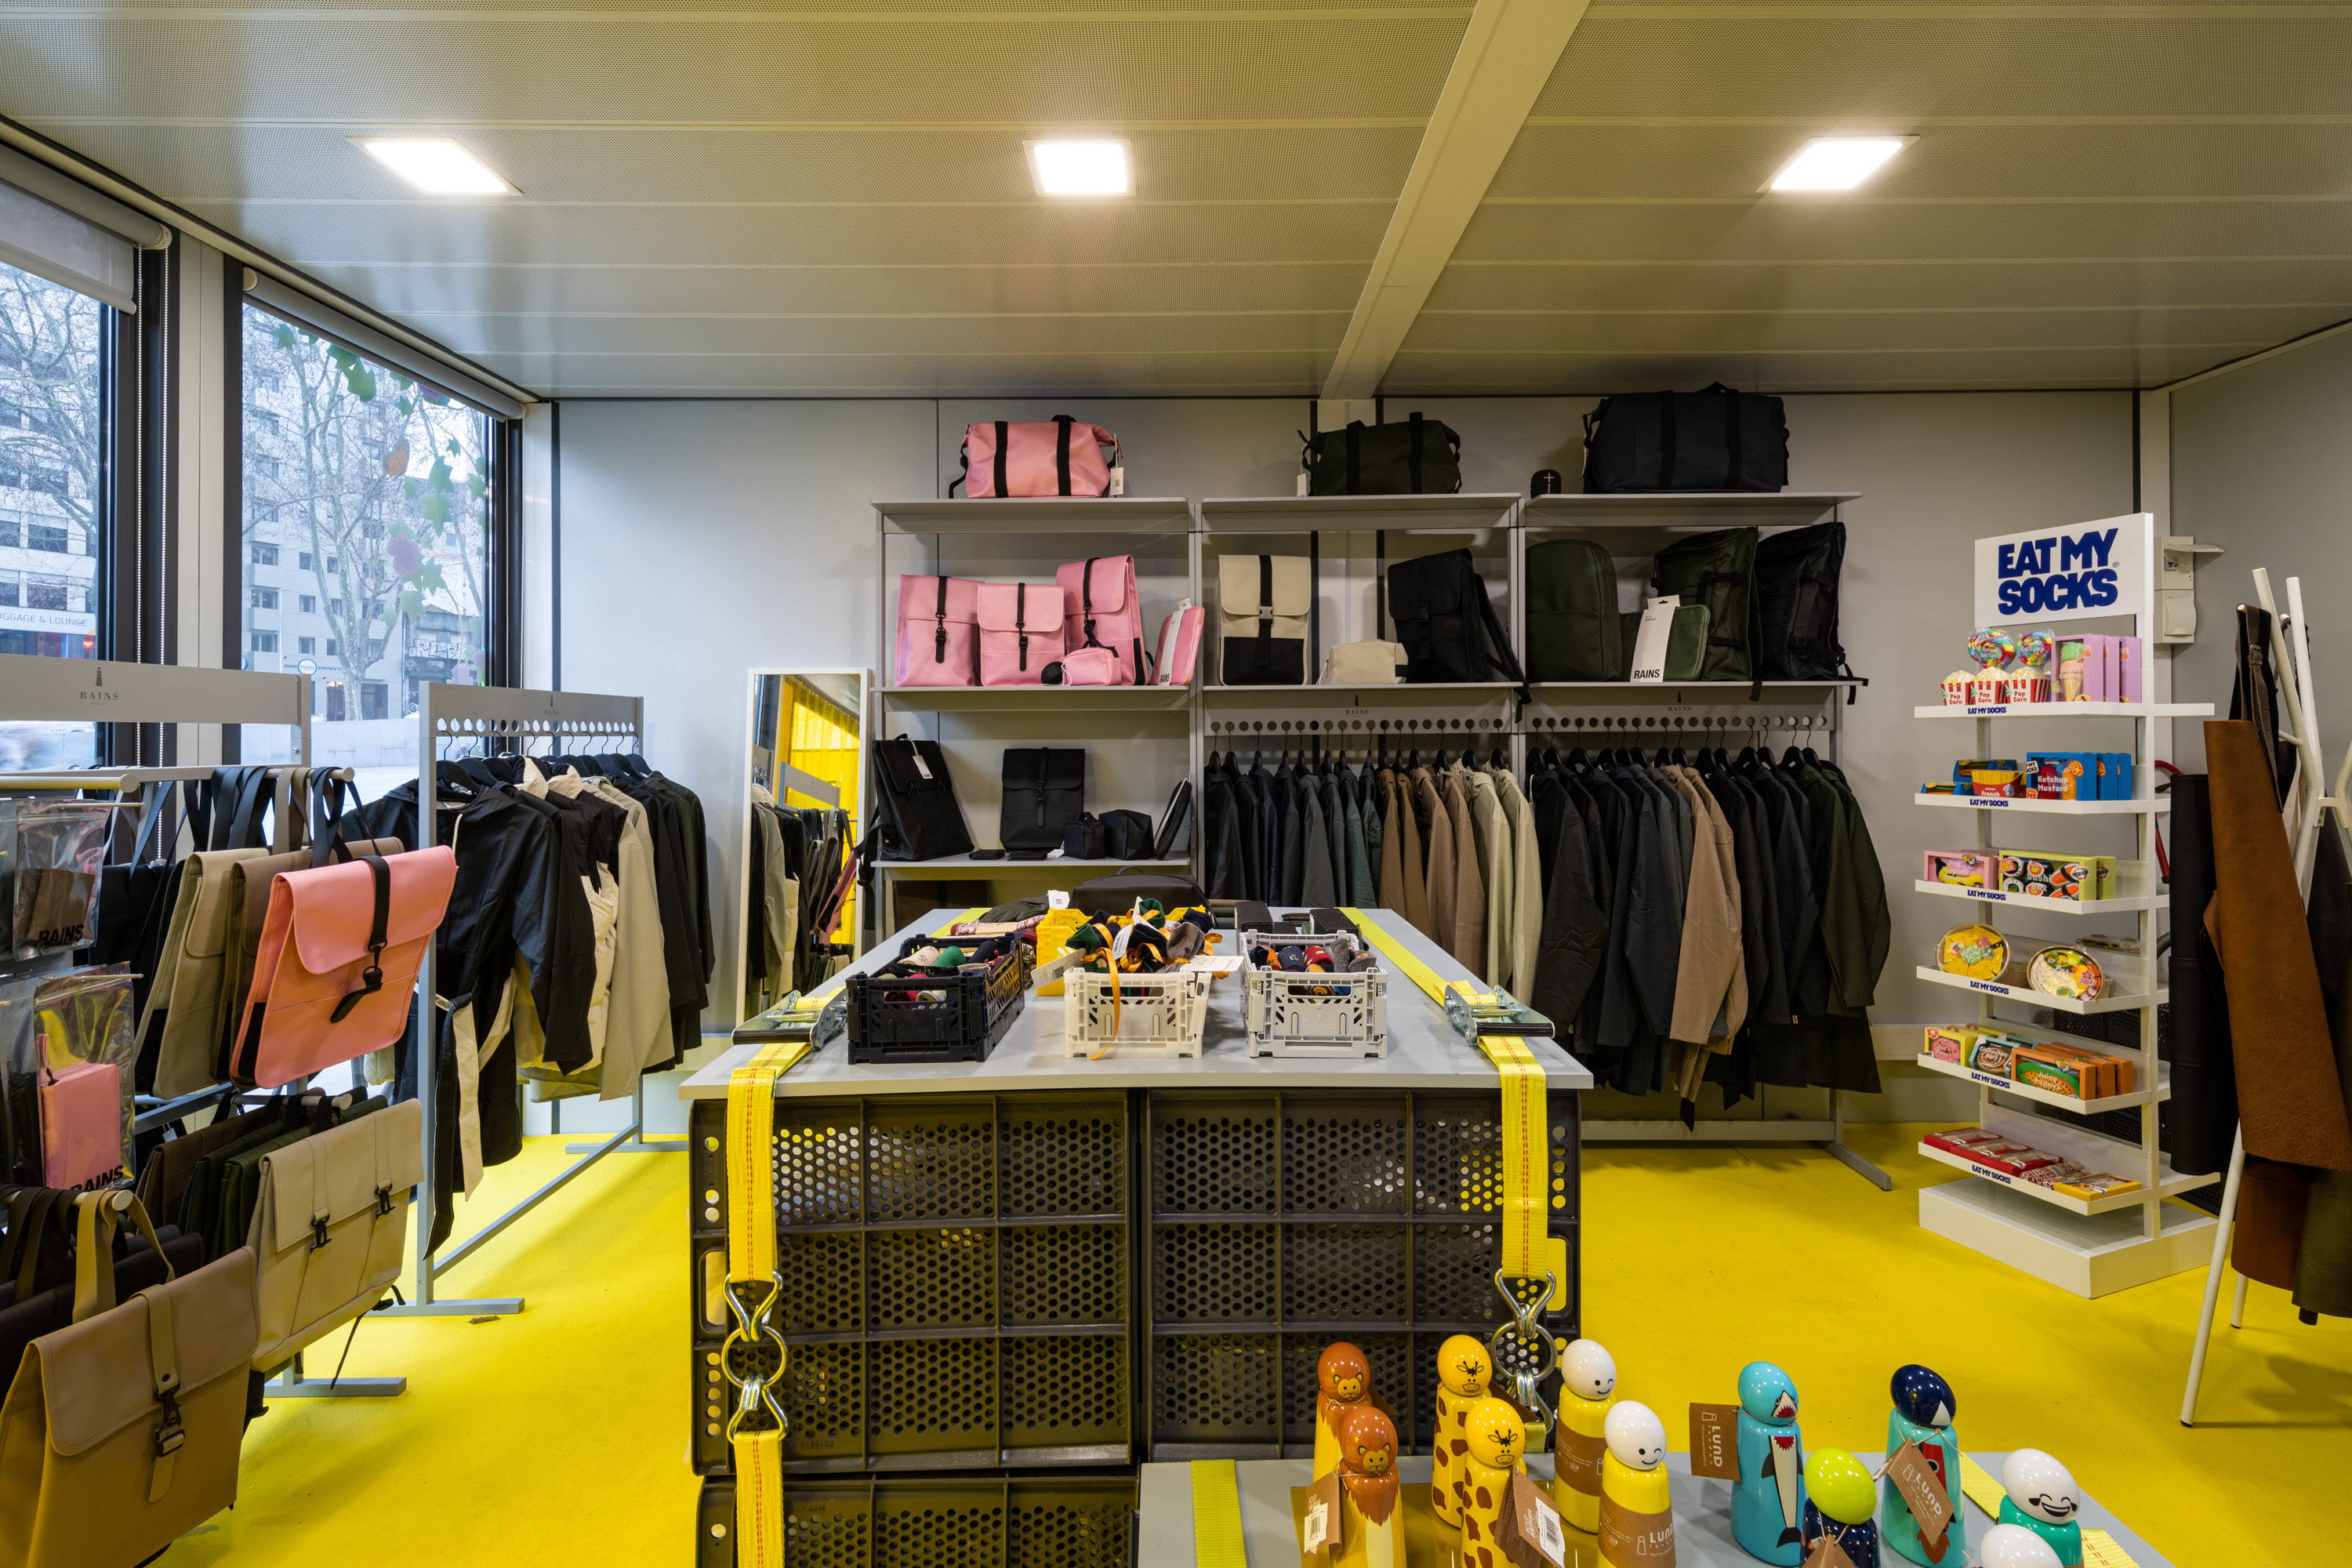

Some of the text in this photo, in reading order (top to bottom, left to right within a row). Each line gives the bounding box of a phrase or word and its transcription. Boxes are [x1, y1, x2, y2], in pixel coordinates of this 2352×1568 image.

[1998, 528, 2118, 579] EAT MY
[1998, 568, 2118, 615] SOCKS
[49, 616, 87, 626] LOUNGE
[1634, 669, 1661, 679] RAINS
[80, 691, 118, 701] RAINS
[2027, 873, 2051, 883] Sushi
[1986, 892, 2005, 901] SOCKS
[39, 924, 85, 944] RAINS
[1990, 984, 2009, 995] SOCKS
[1991, 1077, 2010, 1089] SOCKS
[1972, 1164, 2011, 1184] EAT MY SOCKS
